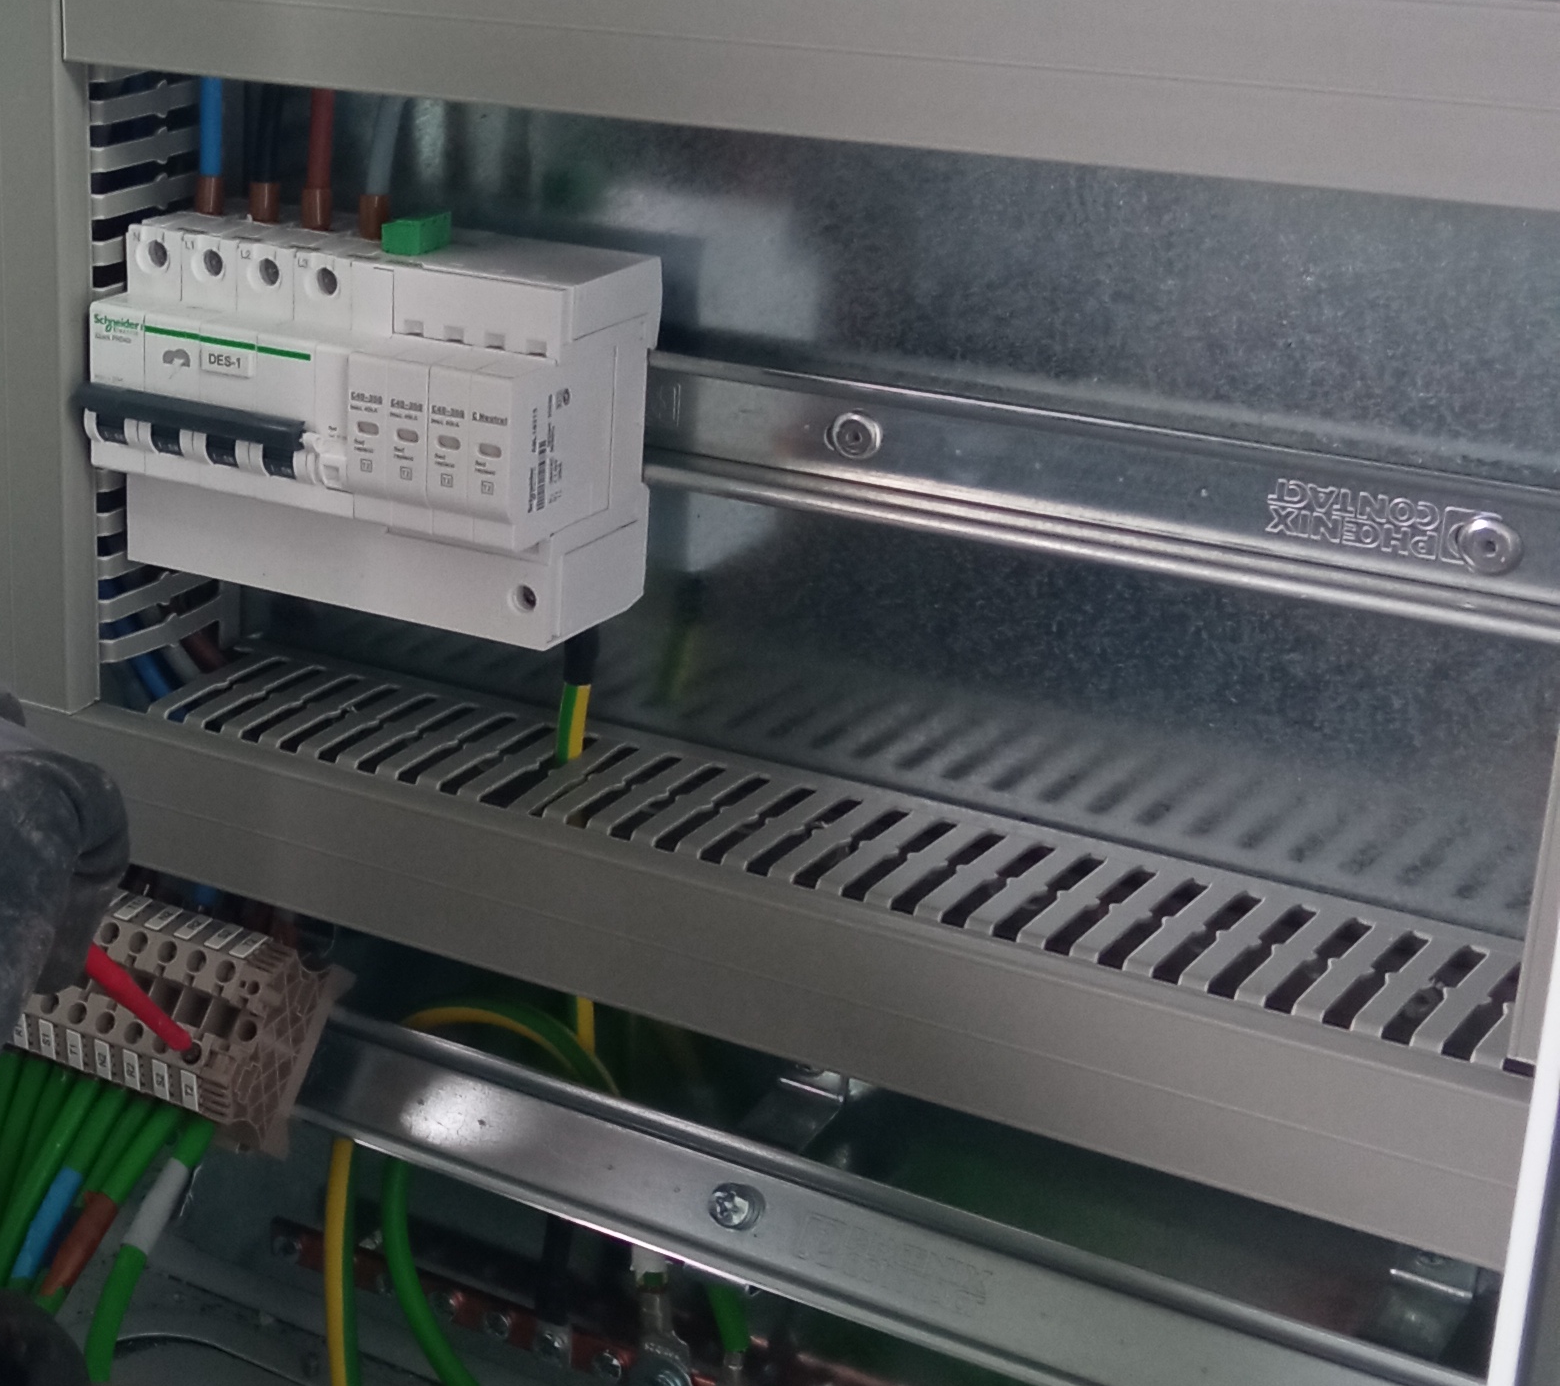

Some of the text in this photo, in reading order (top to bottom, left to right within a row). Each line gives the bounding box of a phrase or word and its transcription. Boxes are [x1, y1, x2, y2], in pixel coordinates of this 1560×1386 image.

[94, 314, 139, 332] Schneider
[209, 353, 241, 368] DES-1
[1267, 478, 1440, 531] CONTACT
